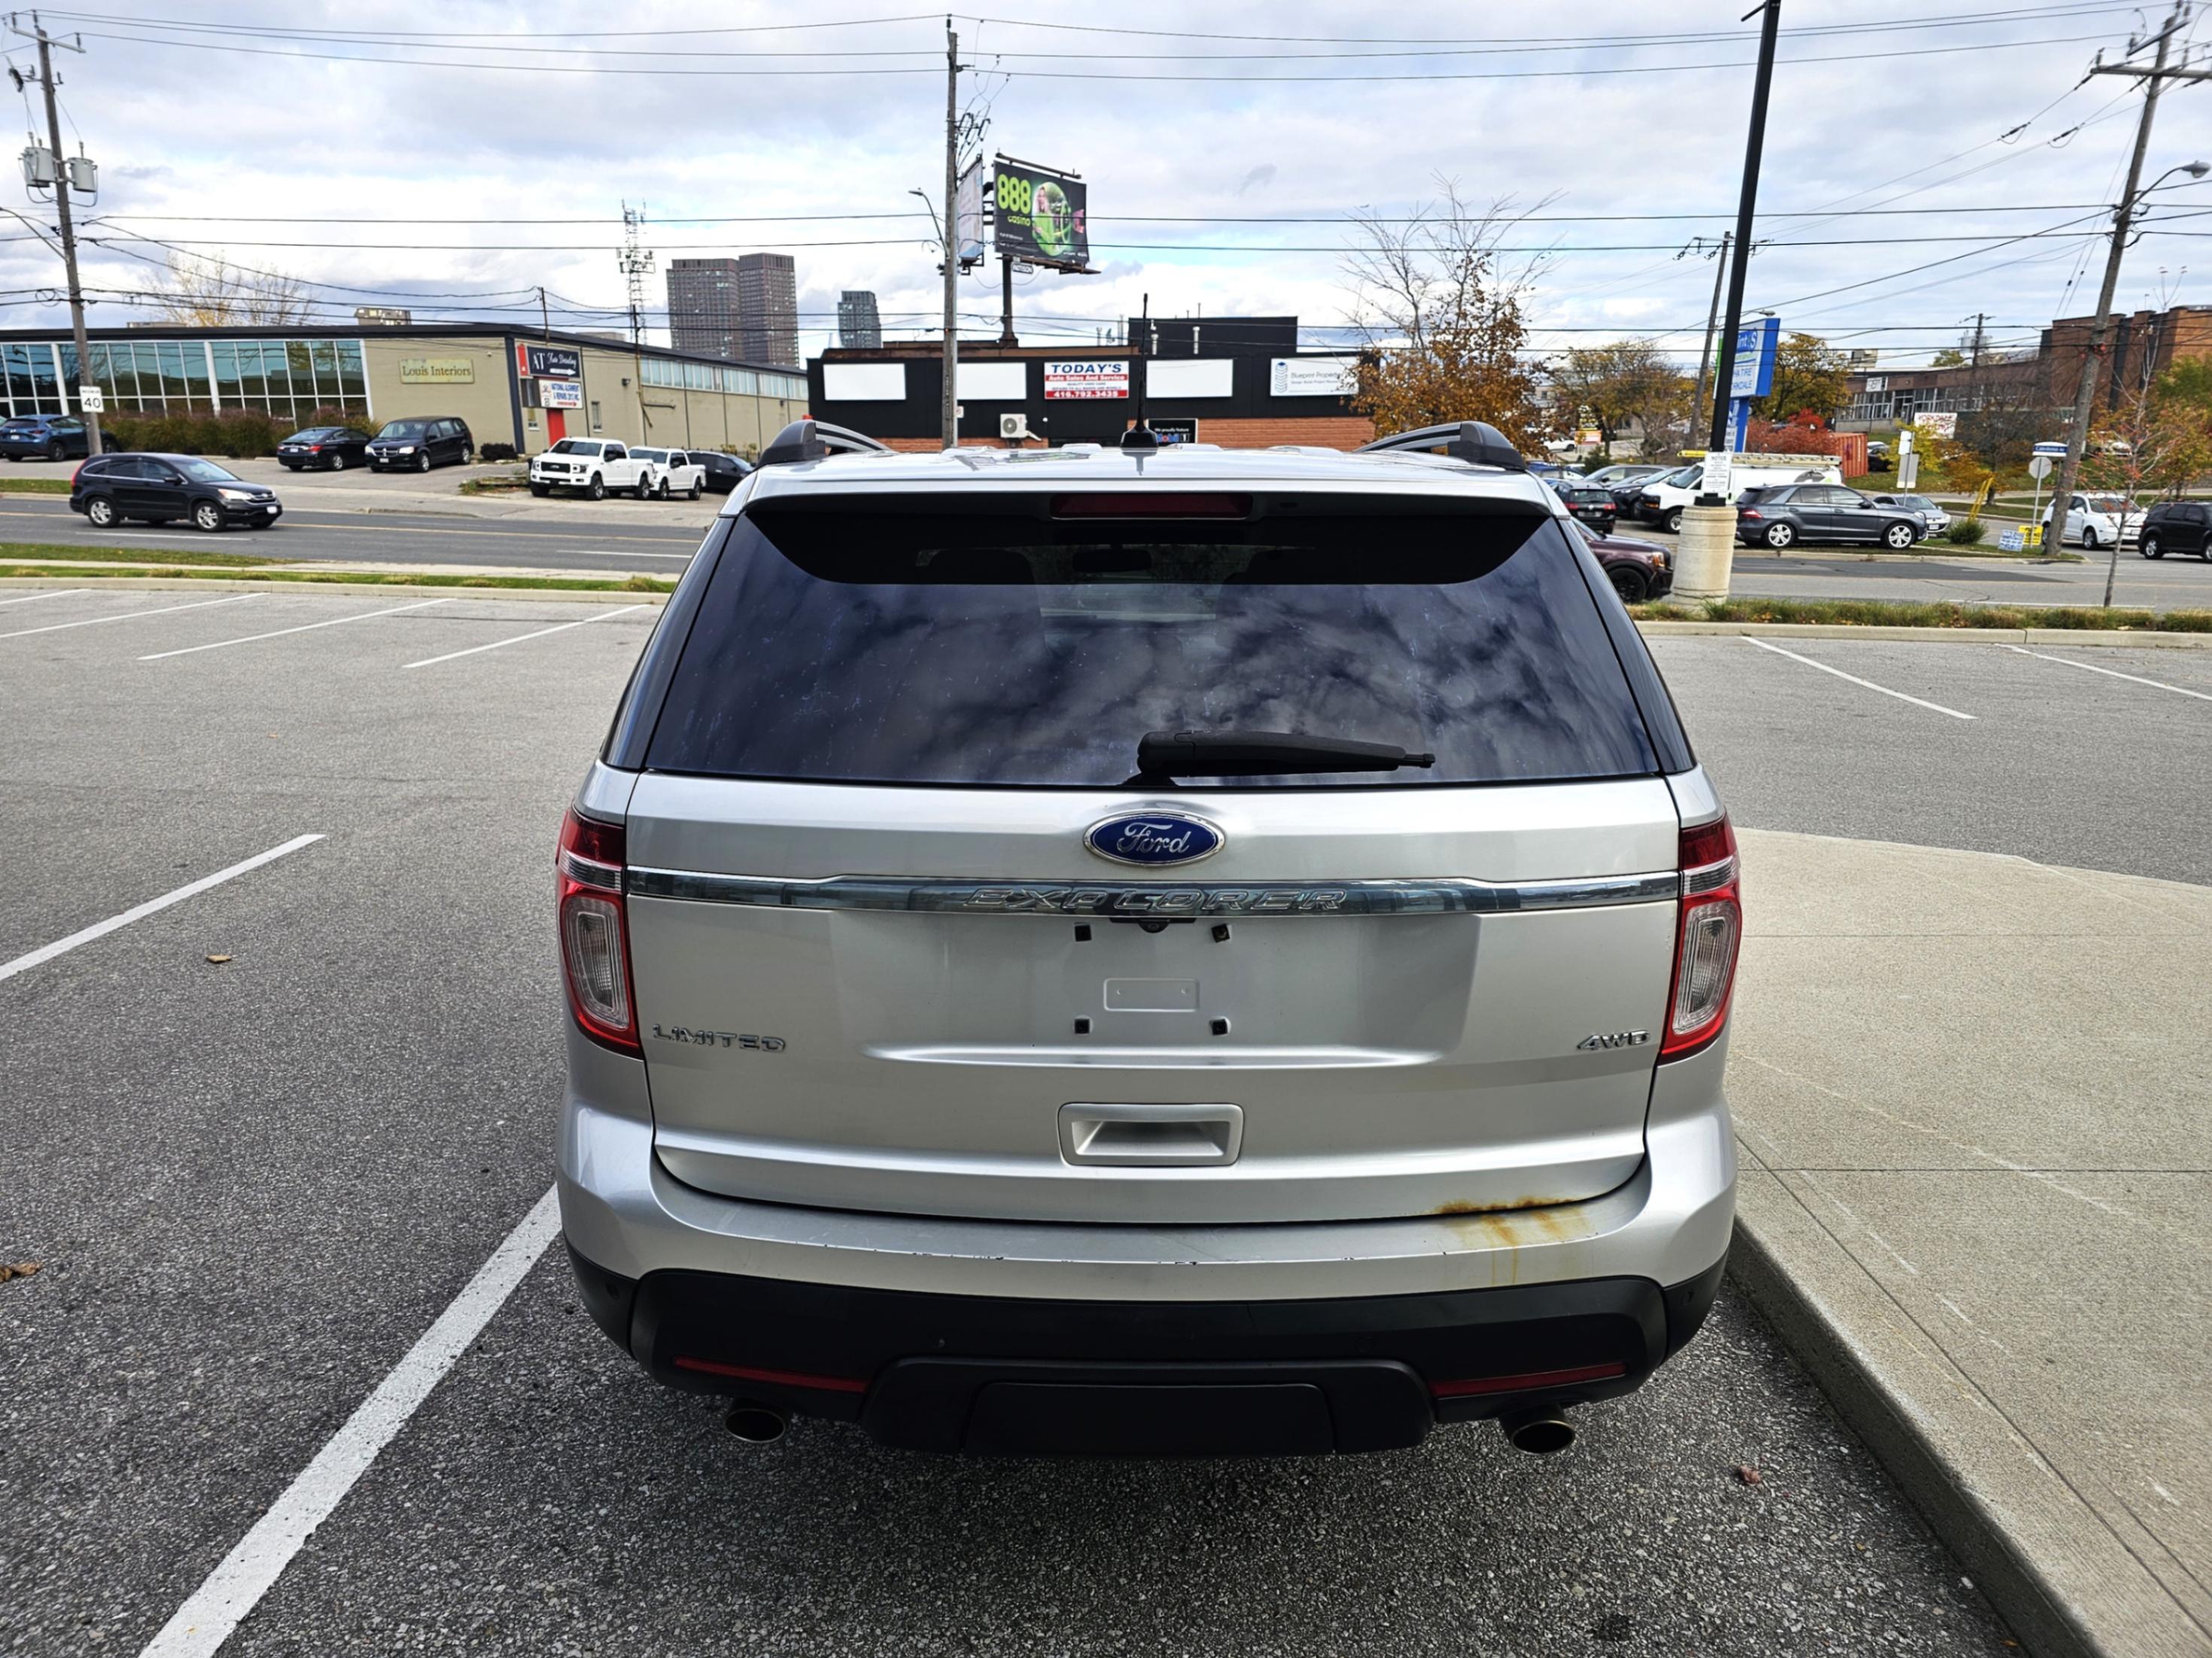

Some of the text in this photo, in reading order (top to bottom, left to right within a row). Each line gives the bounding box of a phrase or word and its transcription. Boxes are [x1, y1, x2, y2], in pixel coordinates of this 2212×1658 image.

[997, 174, 1031, 214] 888
[1008, 215, 1031, 226] casino
[402, 365, 472, 376] Louis Interiors
[1051, 364, 1122, 373] TODAY'S
[84, 397, 101, 409] 40
[1117, 821, 1190, 855] Ford
[964, 887, 1347, 911] EXPLORER
[652, 1024, 787, 1052] LIMITED
[1576, 1029, 1651, 1051] 4WD
